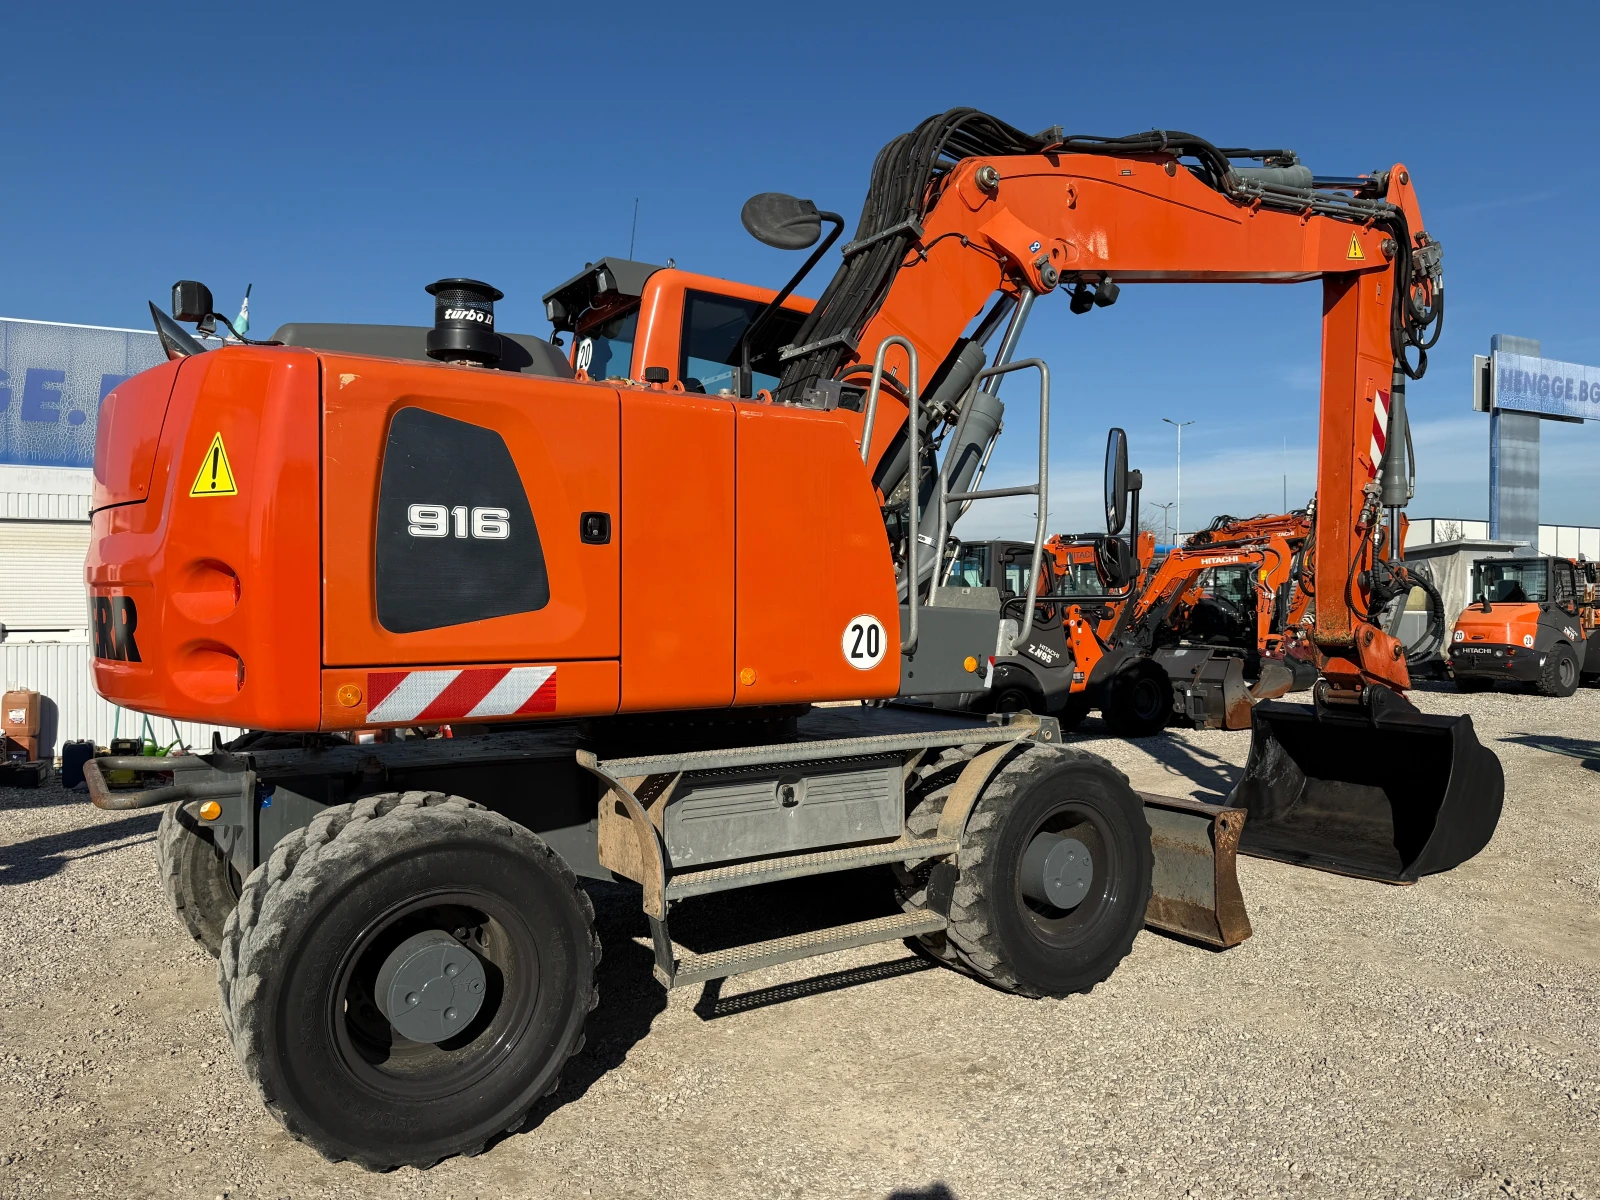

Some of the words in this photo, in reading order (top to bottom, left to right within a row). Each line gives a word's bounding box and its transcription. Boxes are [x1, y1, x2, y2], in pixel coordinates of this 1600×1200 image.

[485, 313, 494, 325] II
[579, 343, 591, 368] 20
[407, 503, 510, 540] 916
[1201, 555, 1239, 565] HITACHI
[851, 624, 880, 658] 20
[1455, 632, 1463, 640] 20
[1039, 643, 1060, 659] HITACHI
[1462, 647, 1492, 655] HITACHI
